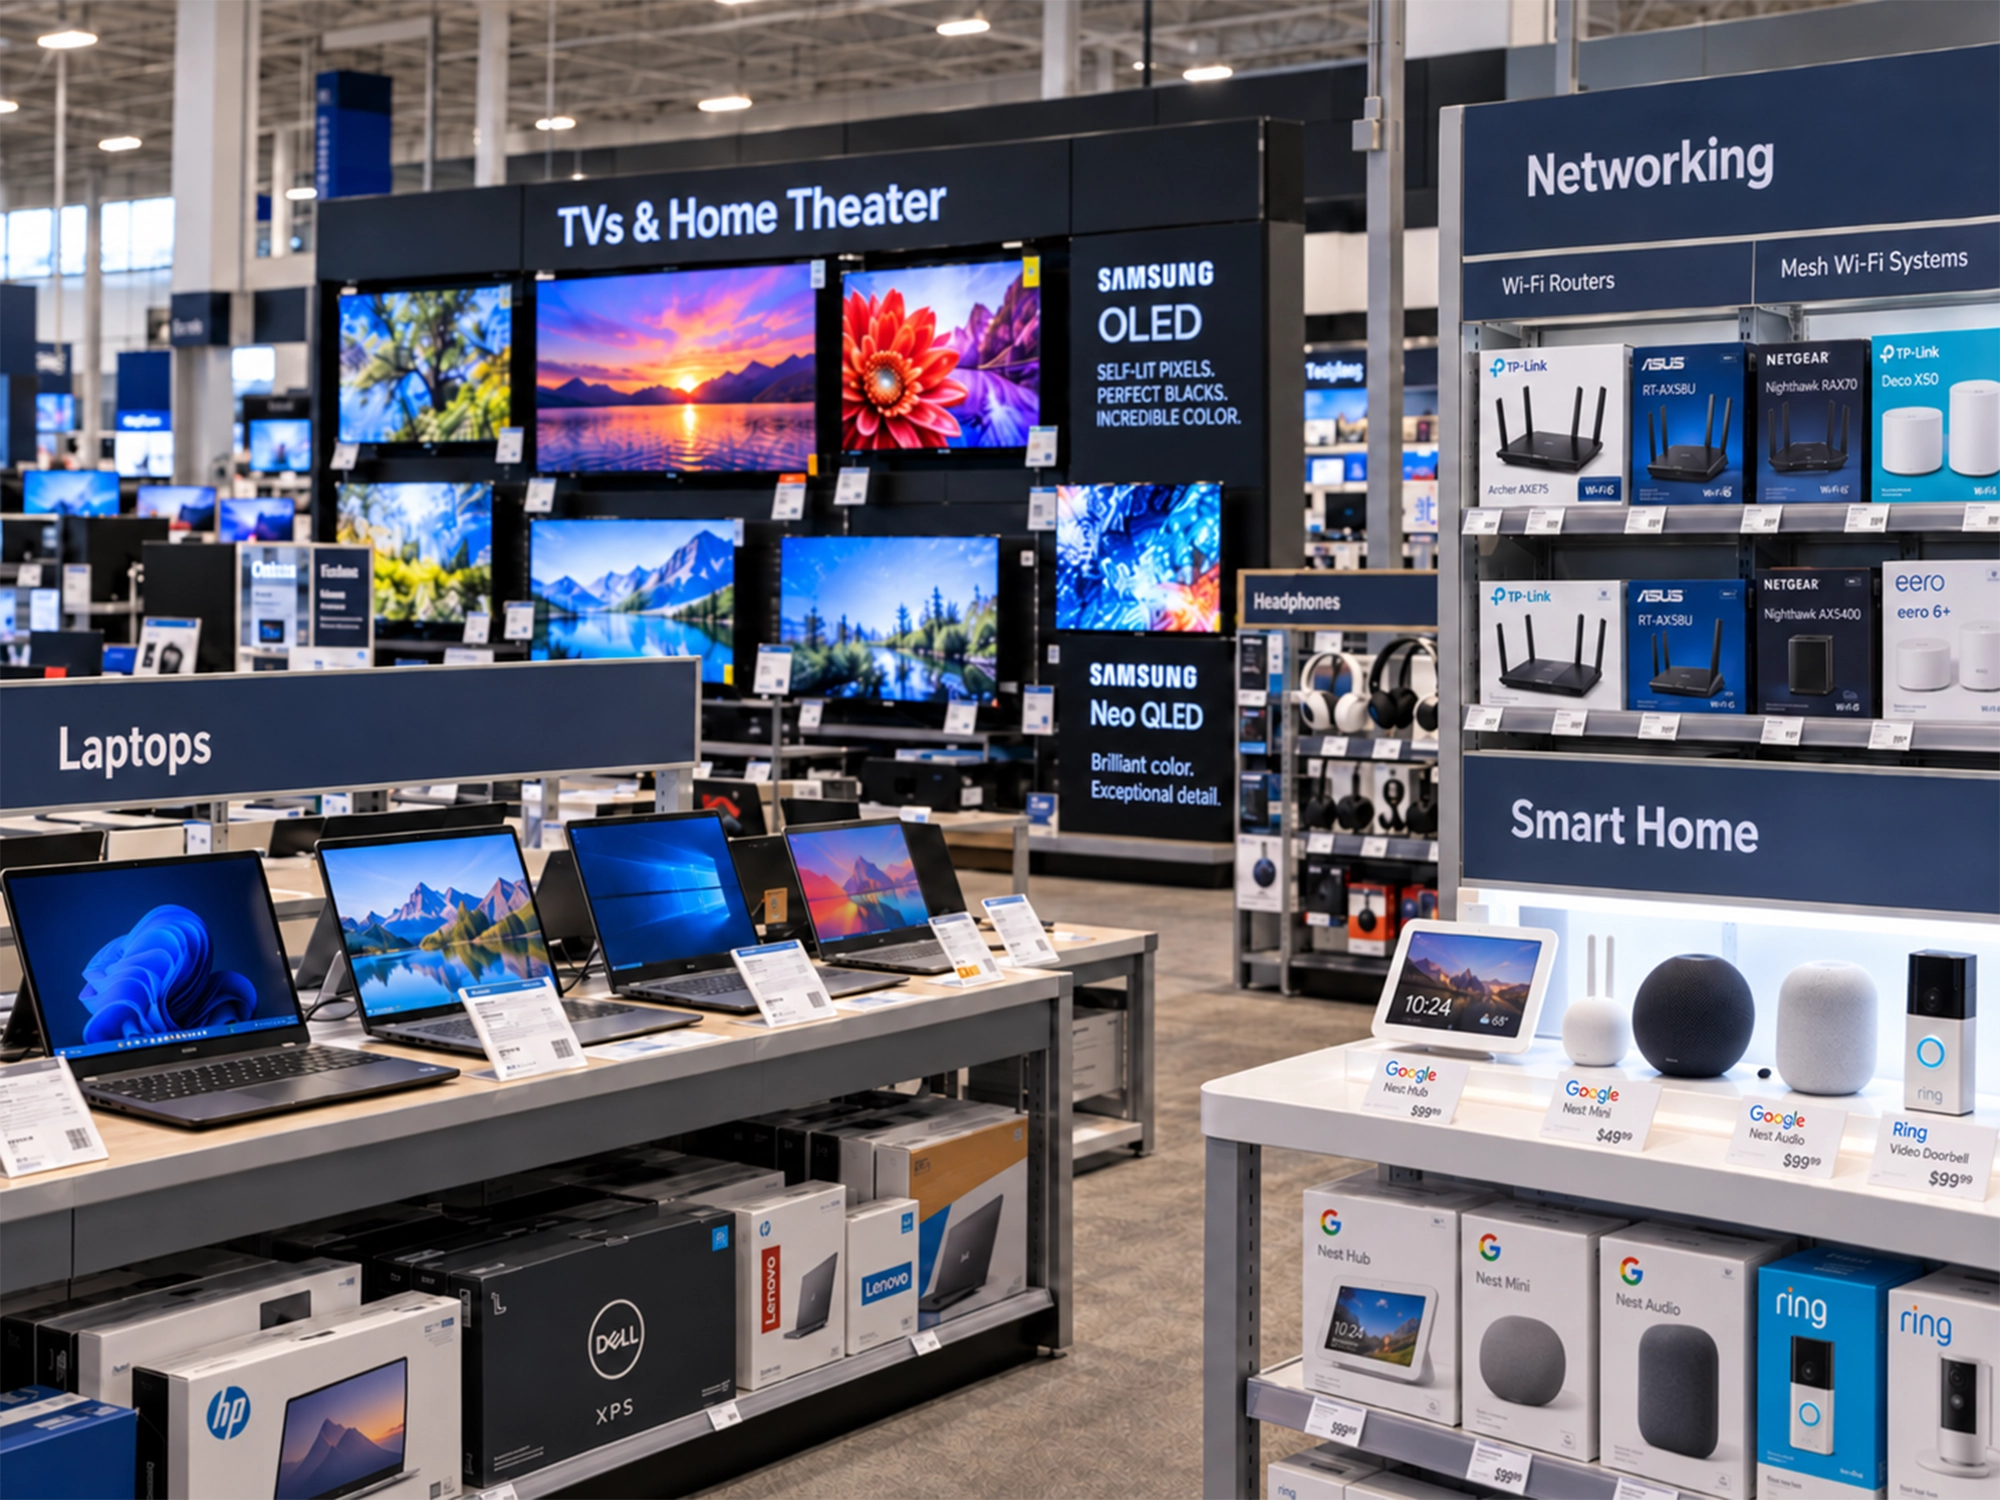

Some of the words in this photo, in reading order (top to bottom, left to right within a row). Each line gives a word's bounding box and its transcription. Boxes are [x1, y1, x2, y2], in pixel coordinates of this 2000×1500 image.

[1527, 135, 1774, 198] Networking
[557, 203, 625, 248] TVs
[632, 200, 661, 243] &
[669, 196, 778, 240] Home
[786, 183, 948, 232] Theater
[1097, 260, 1215, 292] SAMSUNG
[1781, 256, 1829, 278] Mesh
[1834, 252, 1884, 276] Wi-Fi
[1889, 250, 1969, 276] Systems
[1502, 274, 1545, 296] Wi-Fi
[1550, 273, 1616, 293] Routers
[1098, 303, 1203, 344] OLED
[1641, 356, 1685, 372] ASUS
[1766, 351, 1830, 366] NETGEAR
[1896, 346, 1940, 360] TP-Link
[1097, 361, 1156, 381] SELF-LIT
[1159, 360, 1215, 378] PIXELS.
[1506, 360, 1548, 373] TP-Link
[1766, 379, 1820, 396] Nighthawk
[1821, 378, 1859, 392] RAX70
[1881, 374, 1912, 388] Deco
[1097, 385, 1162, 404] PERFECT
[1164, 384, 1228, 402] BLACKS.
[1096, 408, 1180, 427] INCREDIBLE
[1182, 407, 1242, 426] COLOR.
[1764, 578, 1819, 591] NETGEAR
[1895, 574, 1946, 592] eero
[1253, 592, 1341, 614] Headphones
[1508, 590, 1551, 602] TP-Link
[1637, 589, 1684, 602] ASUS
[1764, 608, 1816, 623] Nighthawk
[1897, 606, 1930, 619] eero
[1932, 604, 1950, 618] 6+
[1089, 662, 1198, 689] SAMSUNG
[1090, 699, 1136, 728] Neo
[1140, 701, 1204, 730] QLED
[60, 726, 212, 780] Laptops
[1091, 752, 1148, 774] Brilliant
[1150, 756, 1194, 777] color.
[1091, 780, 1174, 805] Exceptional
[1176, 785, 1222, 806] detail.
[1511, 798, 1626, 845] Smart
[1637, 805, 1759, 854] Home
[1405, 994, 1453, 1018] 10:24
[1386, 1060, 1437, 1084] Google
[1566, 1079, 1620, 1104] Google
[1917, 1086, 1943, 1106] ring
[1750, 1104, 1806, 1130] Google
[1749, 1128, 1773, 1142] Nest
[1774, 1130, 1805, 1146] Audio
[1892, 1120, 1928, 1144] Ring
[1890, 1143, 1920, 1158] Video
[1923, 1147, 1970, 1164] Doorbell
[1317, 1244, 1344, 1262] Nest
[1346, 1248, 1372, 1266] Hub
[764, 1256, 776, 1326] Lenovo
[865, 1272, 908, 1298] Lenovo
[1476, 1270, 1503, 1288] Nest
[1505, 1276, 1531, 1293] Mini
[1616, 1292, 1643, 1310] Nest
[1645, 1297, 1682, 1316] Audio
[1776, 1286, 1828, 1329] ring
[1900, 1304, 1953, 1347] ring
[596, 1325, 640, 1355] DELL
[210, 1387, 249, 1440] hp
[596, 1398, 634, 1426] XPS
